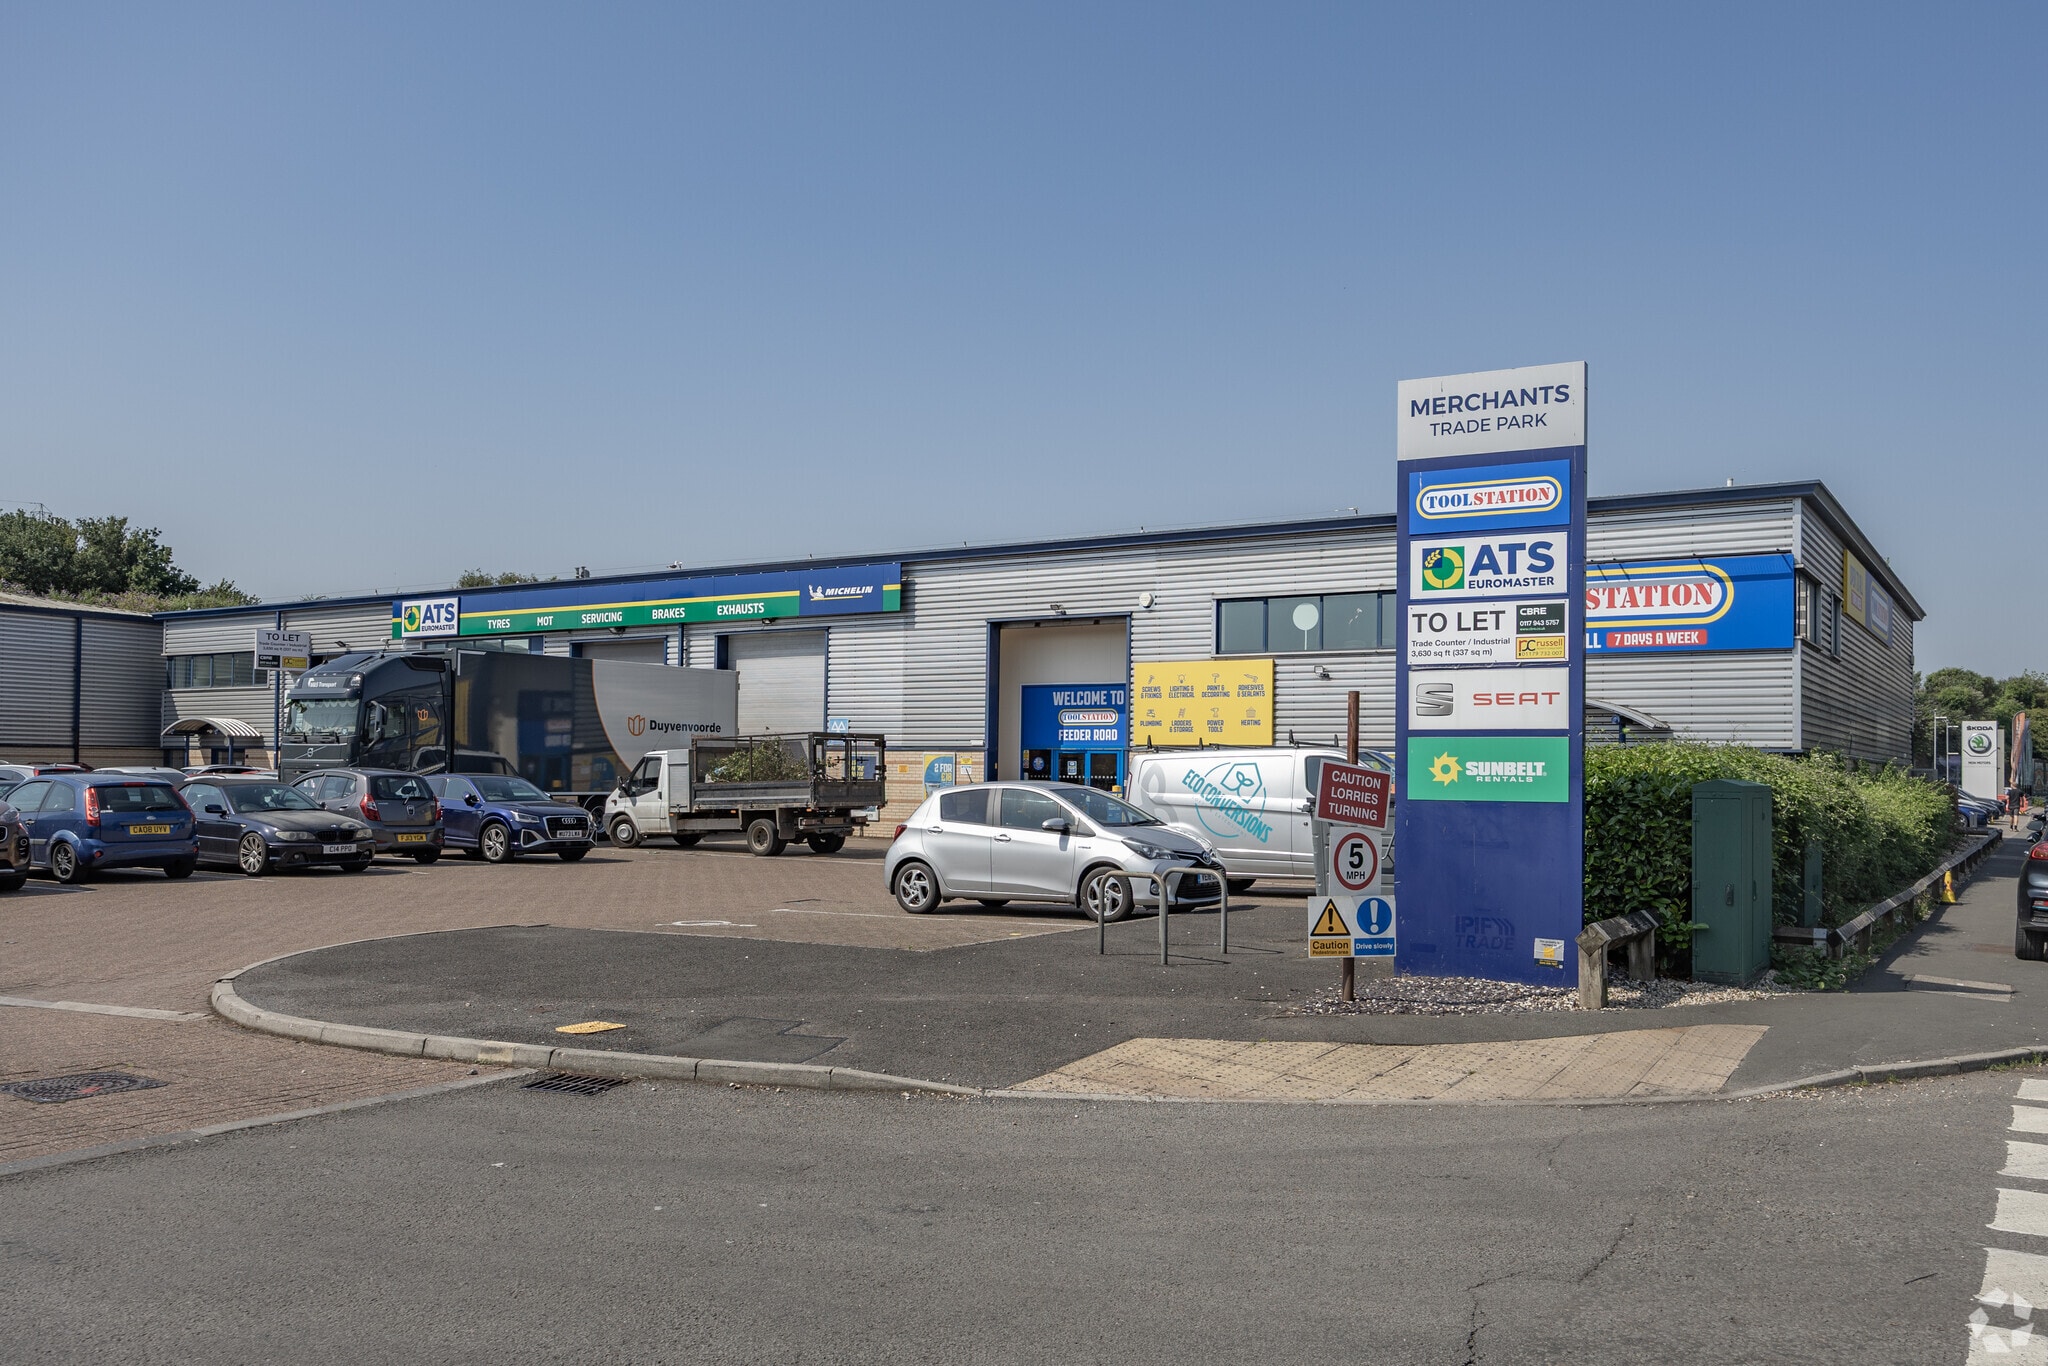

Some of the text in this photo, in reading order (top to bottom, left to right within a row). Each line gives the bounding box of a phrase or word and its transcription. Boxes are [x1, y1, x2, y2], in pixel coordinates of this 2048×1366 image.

[1411, 384, 1570, 417] MERCHANTS
[1430, 413, 1547, 436] TRADE PARK
[1426, 487, 1550, 508] TOOLSTATION
[1469, 541, 1555, 576] ATS
[1468, 576, 1554, 589] EUROMASTER
[825, 586, 873, 596] MICHELIN
[1586, 583, 1714, 610] STATION
[422, 602, 456, 624] ATS
[652, 608, 686, 620] BRAKES
[717, 602, 764, 616] EXHAUSTS
[488, 618, 510, 629] TYRES
[536, 616, 554, 626] MOT
[581, 612, 622, 624] SERVICING
[1412, 610, 1506, 633] TO LET
[266, 632, 280, 640] TO
[1474, 638, 1510, 646] Industrial
[1536, 638, 1562, 646] russell
[1614, 632, 1699, 646] 7 DAYS A WEEK
[1452, 649, 1468, 657] (337
[1482, 648, 1492, 656] m)
[1052, 690, 1124, 706] WELCOME TO
[1473, 692, 1560, 706] SEAT
[650, 720, 722, 734] Duyvenvoorde
[1058, 729, 1118, 740] FEEDER ROAD
[934, 764, 938, 772] 2
[940, 764, 952, 772] FOR
[1466, 762, 1546, 776] SUNBELT
[1332, 770, 1381, 790] CAUTION
[1331, 786, 1378, 805] LORRIES
[1182, 768, 1274, 844] ECO CONVERSIONS
[1328, 802, 1378, 821] TURNING
[133, 826, 152, 834] CA08
[1348, 843, 1364, 869] 5
[1346, 870, 1366, 880] MPH
[1312, 940, 1348, 950] Caution
[1456, 934, 1514, 950] TRADE
